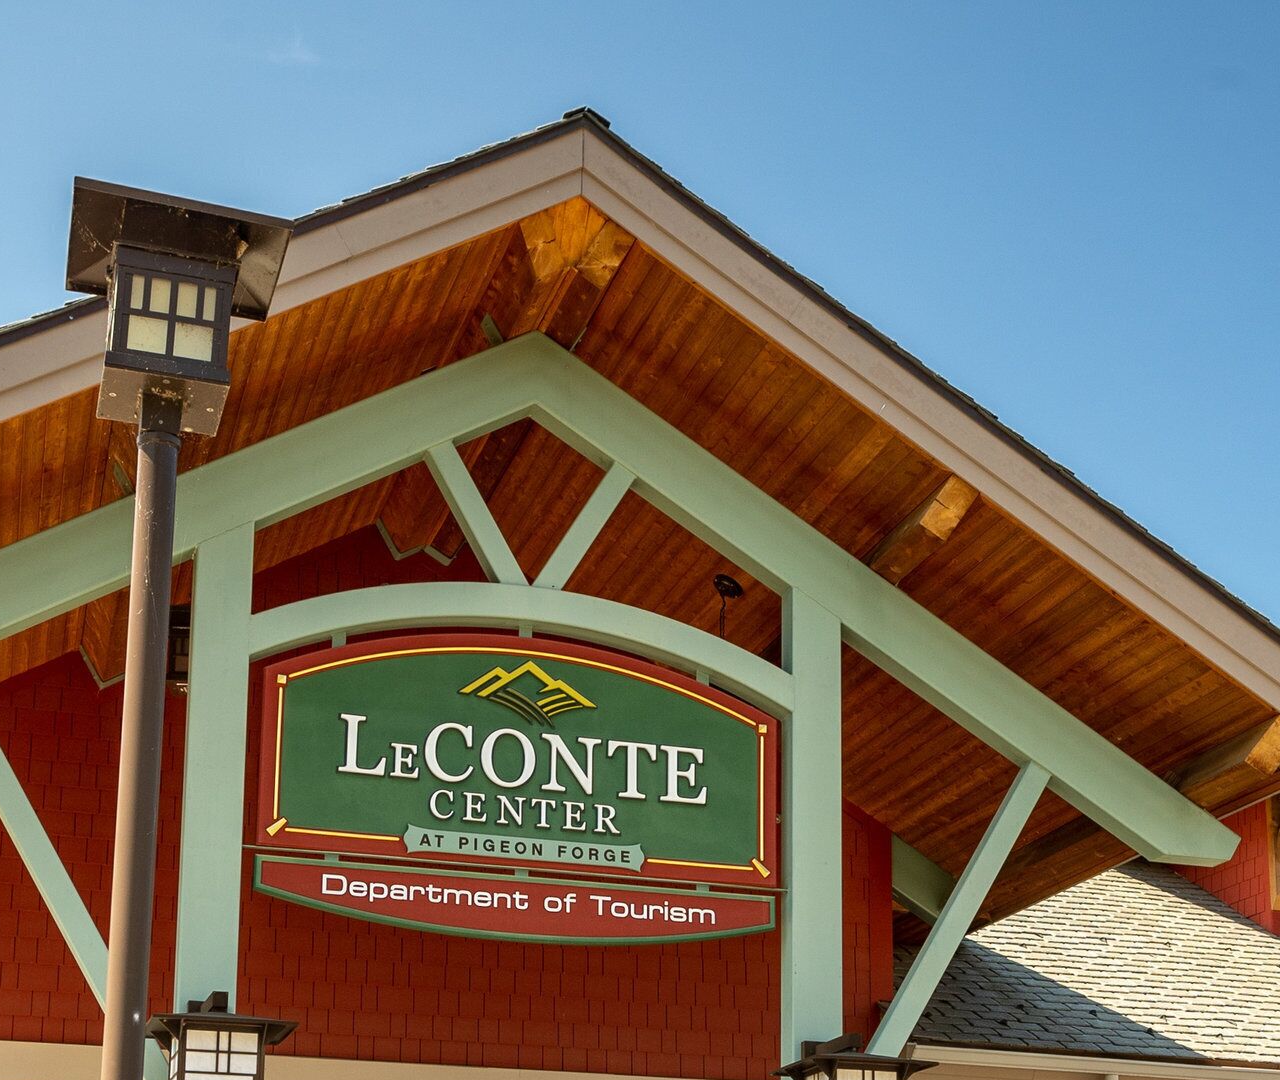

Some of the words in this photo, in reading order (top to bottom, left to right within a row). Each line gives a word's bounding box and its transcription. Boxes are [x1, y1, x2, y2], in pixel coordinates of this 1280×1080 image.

[428, 788, 622, 835] CENTER
[419, 833, 446, 848] AT
[457, 836, 544, 857] PIGEON
[556, 845, 632, 865] FORGE
[320, 872, 530, 911] Department
[542, 892, 578, 915] of
[588, 894, 717, 926] Tourism
